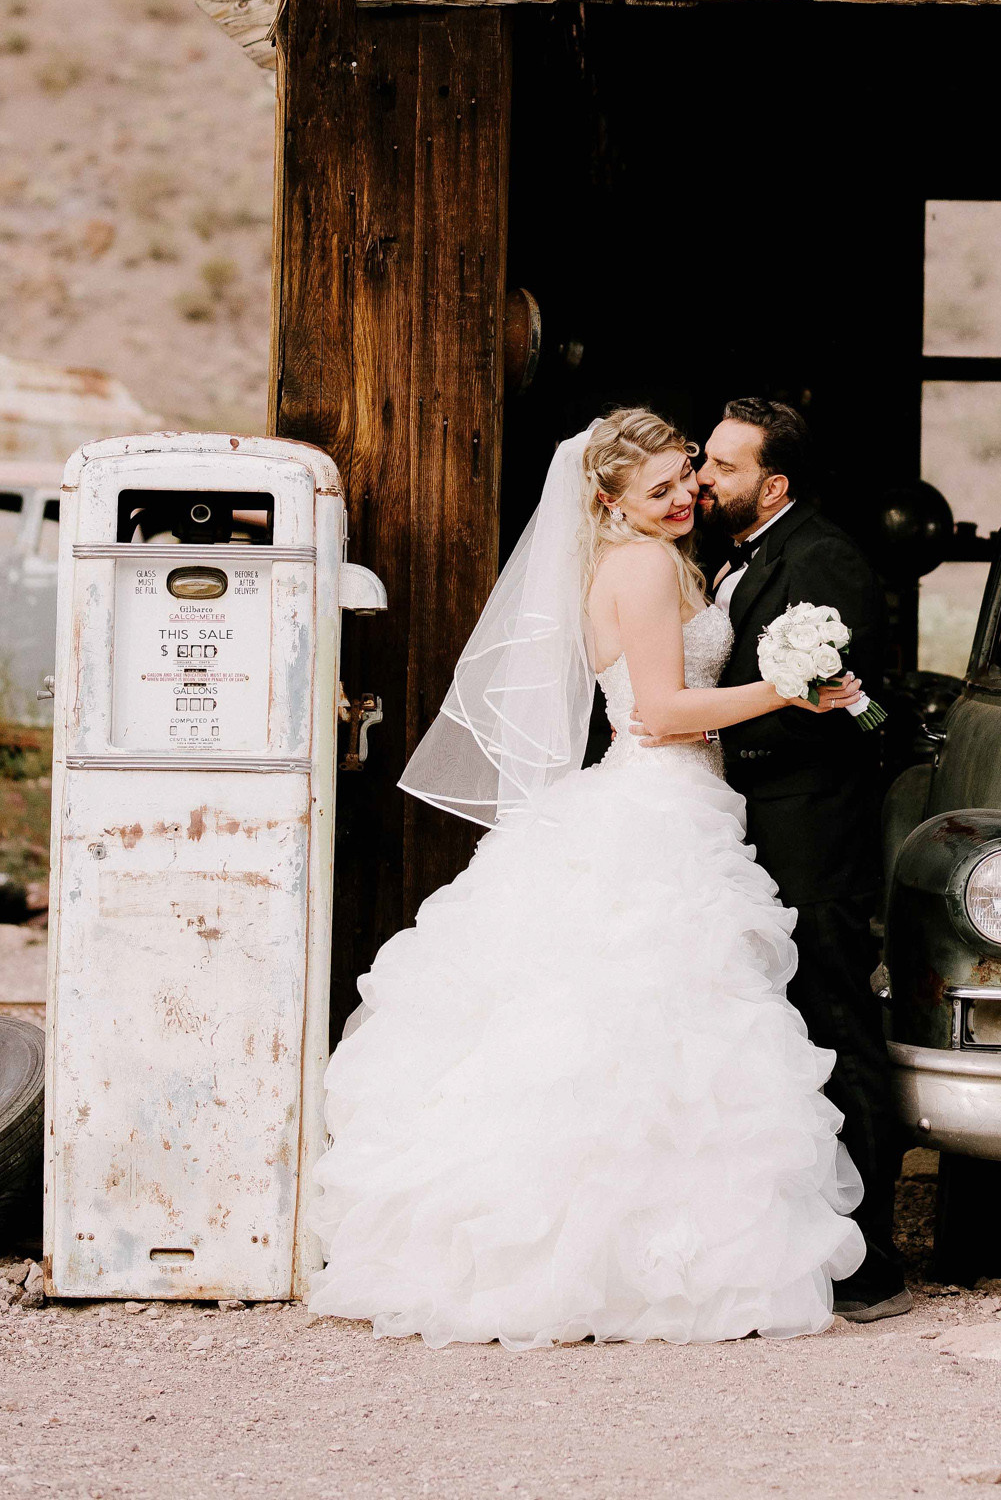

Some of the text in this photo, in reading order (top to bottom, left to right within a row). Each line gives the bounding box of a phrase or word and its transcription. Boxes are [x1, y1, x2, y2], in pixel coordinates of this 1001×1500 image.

[136, 570, 157, 578] GLASS
[234, 570, 254, 578] BEFORE
[239, 579, 256, 587] AFTER
[135, 586, 158, 594] BE FULL
[234, 587, 259, 595] DELIVERY
[179, 605, 213, 613] Gilbarco
[158, 629, 234, 640] THIS SALE
[160, 644, 169, 657] $
[173, 686, 218, 695] GALLONS
